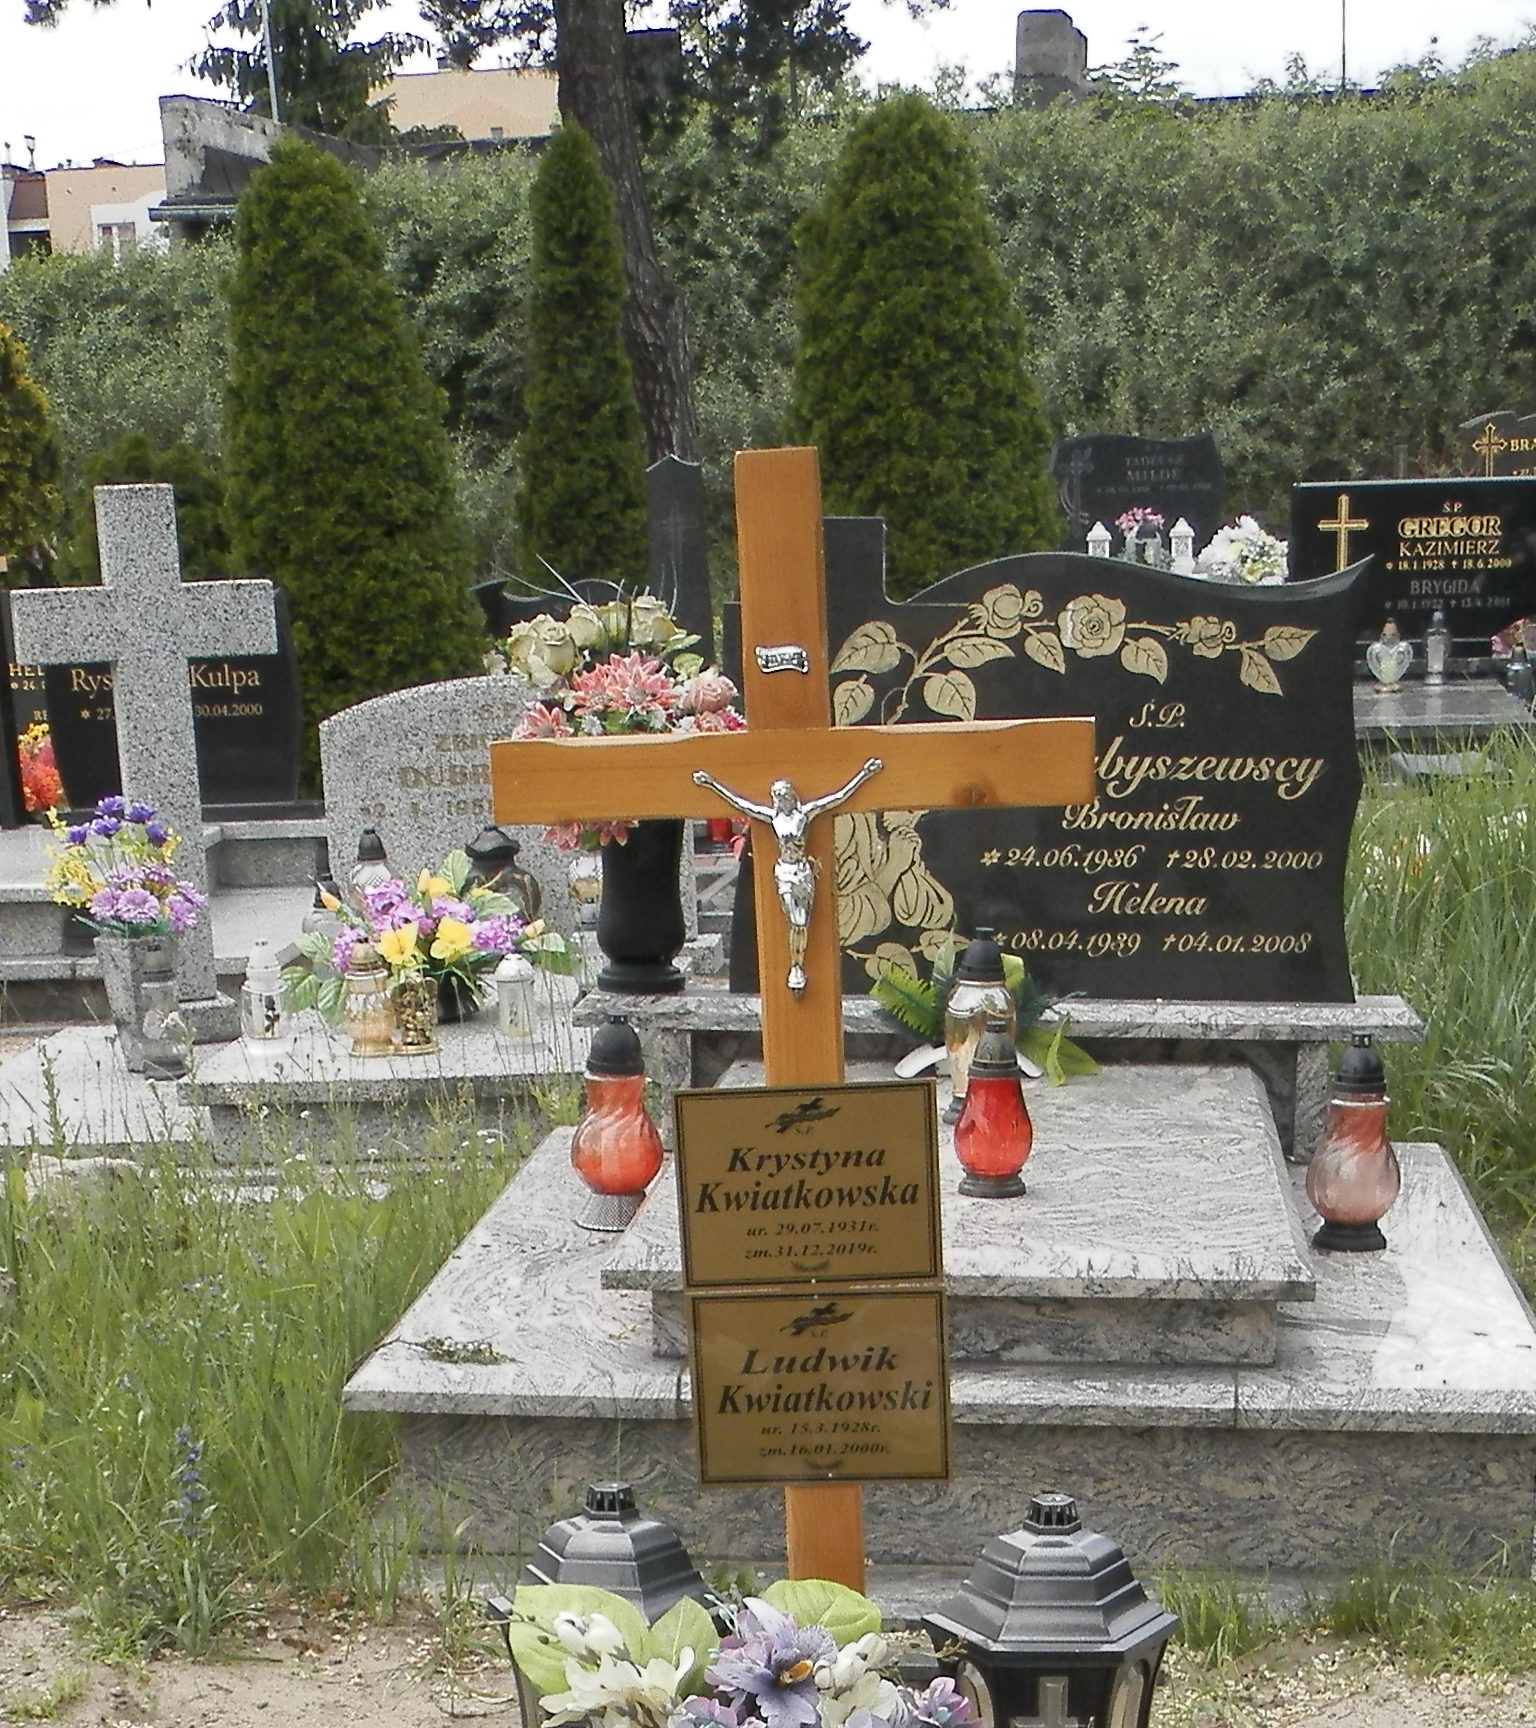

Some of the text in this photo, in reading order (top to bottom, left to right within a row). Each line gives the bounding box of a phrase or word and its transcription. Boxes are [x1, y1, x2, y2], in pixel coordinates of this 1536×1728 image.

[1398, 516, 1503, 538] GREGOR
[1399, 540, 1500, 557] KAZIMIERZ
[1410, 579, 1482, 595] BRYGIDA
[188, 664, 260, 694] Kulpa
[1094, 735, 1326, 801] byszewscy
[1004, 844, 1325, 875] 24.06.1936 28.02.2000
[1087, 880, 1209, 916] Helena
[1011, 929, 1312, 958] 08.04.1939 04.01.2008
[727, 1147, 887, 1178] Krystyna
[695, 1175, 920, 1213] Kwiatkowska
[746, 1225, 768, 1237] ur.
[741, 1346, 899, 1375] Ludwik
[717, 1380, 934, 1415] Kwiatkowski
[761, 1426, 782, 1436] ur.
